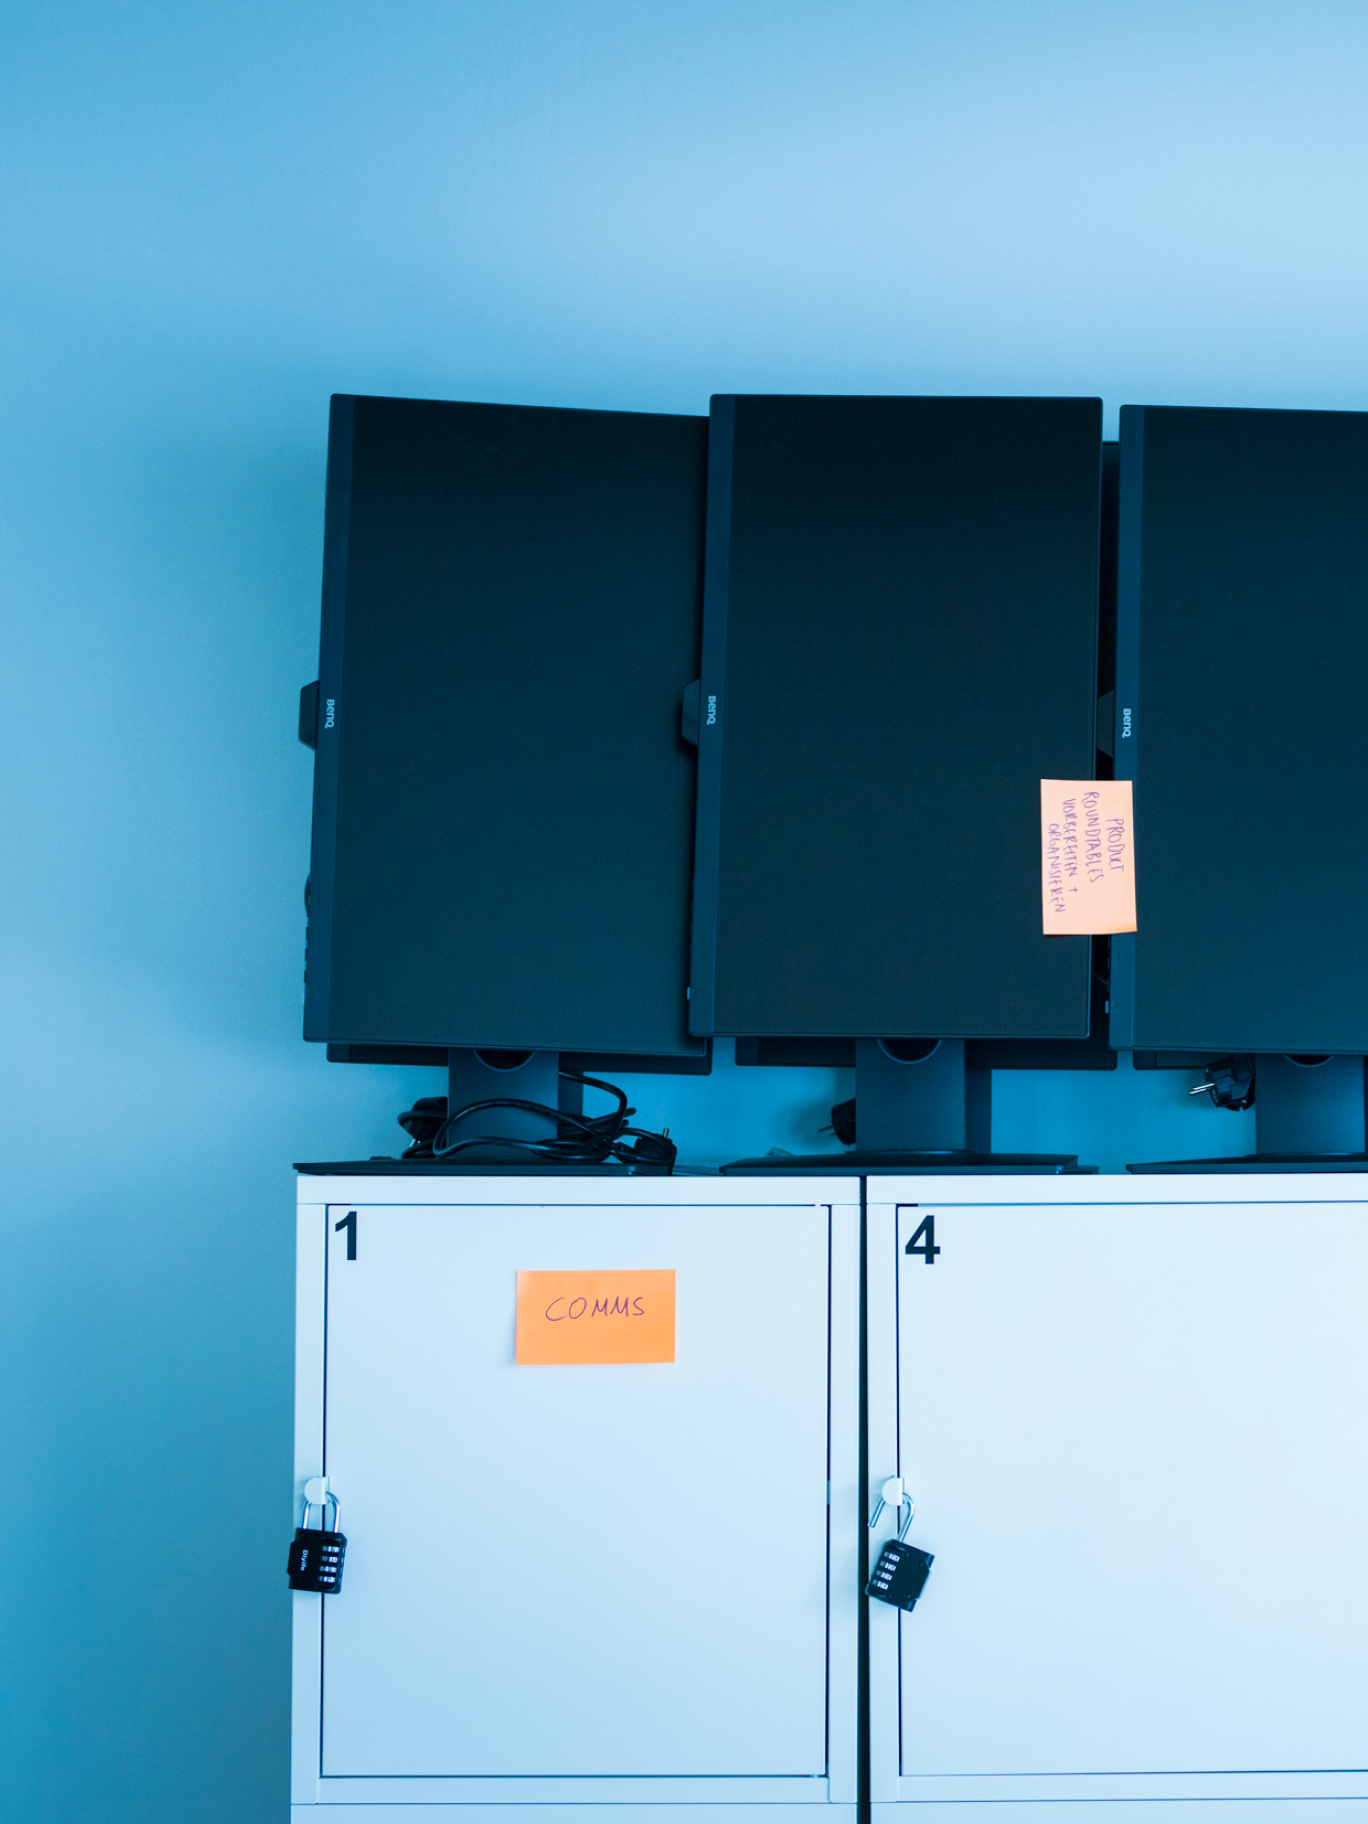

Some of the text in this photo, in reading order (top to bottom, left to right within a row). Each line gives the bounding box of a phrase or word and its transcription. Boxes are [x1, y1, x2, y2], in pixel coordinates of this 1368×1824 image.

[324, 698, 335, 729] BenQ
[706, 695, 717, 726] BenQ
[1121, 708, 1132, 739] BenQ
[1081, 791, 1104, 883] ROUNDTABLES
[335, 1211, 357, 1261] 1
[904, 1215, 941, 1265] 4
[545, 1296, 645, 1322] COMMS
